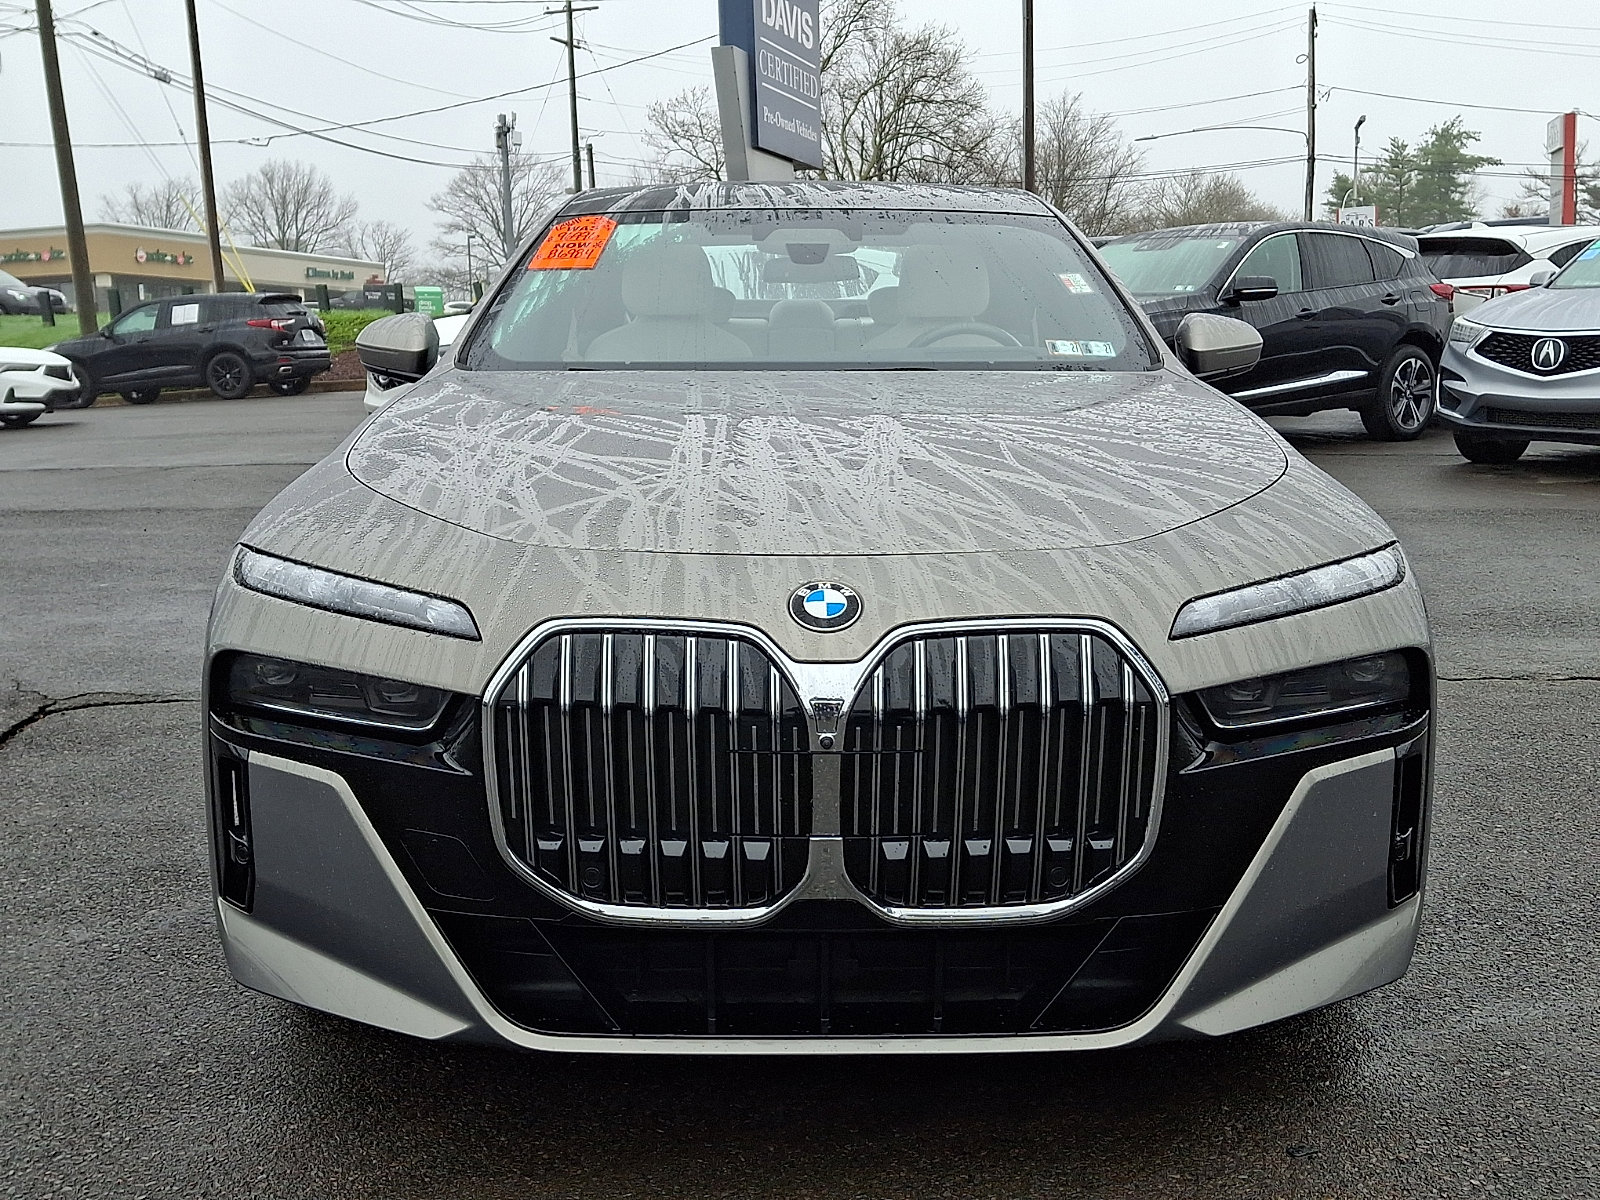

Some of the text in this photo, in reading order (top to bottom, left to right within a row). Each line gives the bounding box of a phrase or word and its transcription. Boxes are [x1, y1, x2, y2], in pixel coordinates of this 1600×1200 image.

[761, 0, 813, 49] DAVIS
[759, 49, 818, 99] CERTIFIED
[763, 106, 818, 142] Pre-Owned Vehicles
[797, 582, 855, 597] BMW
